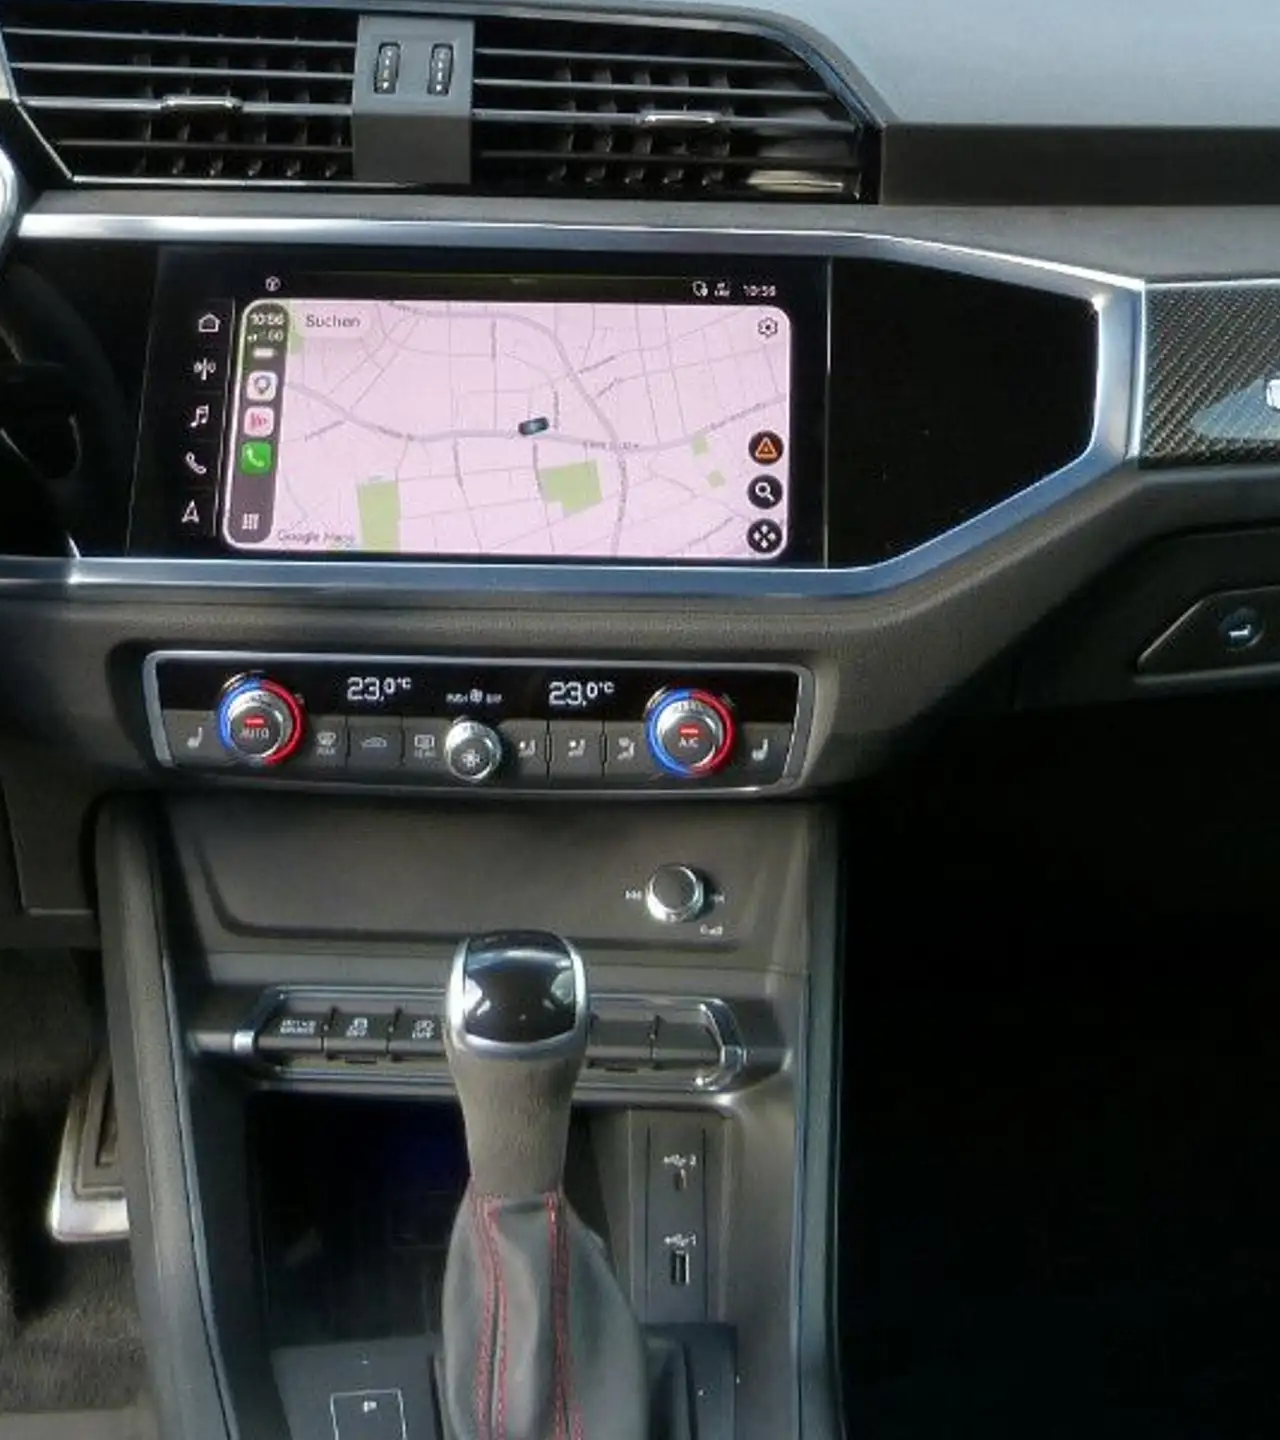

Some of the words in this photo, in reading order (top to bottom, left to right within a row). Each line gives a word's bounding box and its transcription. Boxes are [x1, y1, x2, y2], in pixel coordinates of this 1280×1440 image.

[305, 314, 361, 329] Suchen
[239, 726, 270, 740] AUTO
[678, 736, 700, 749] A/C
